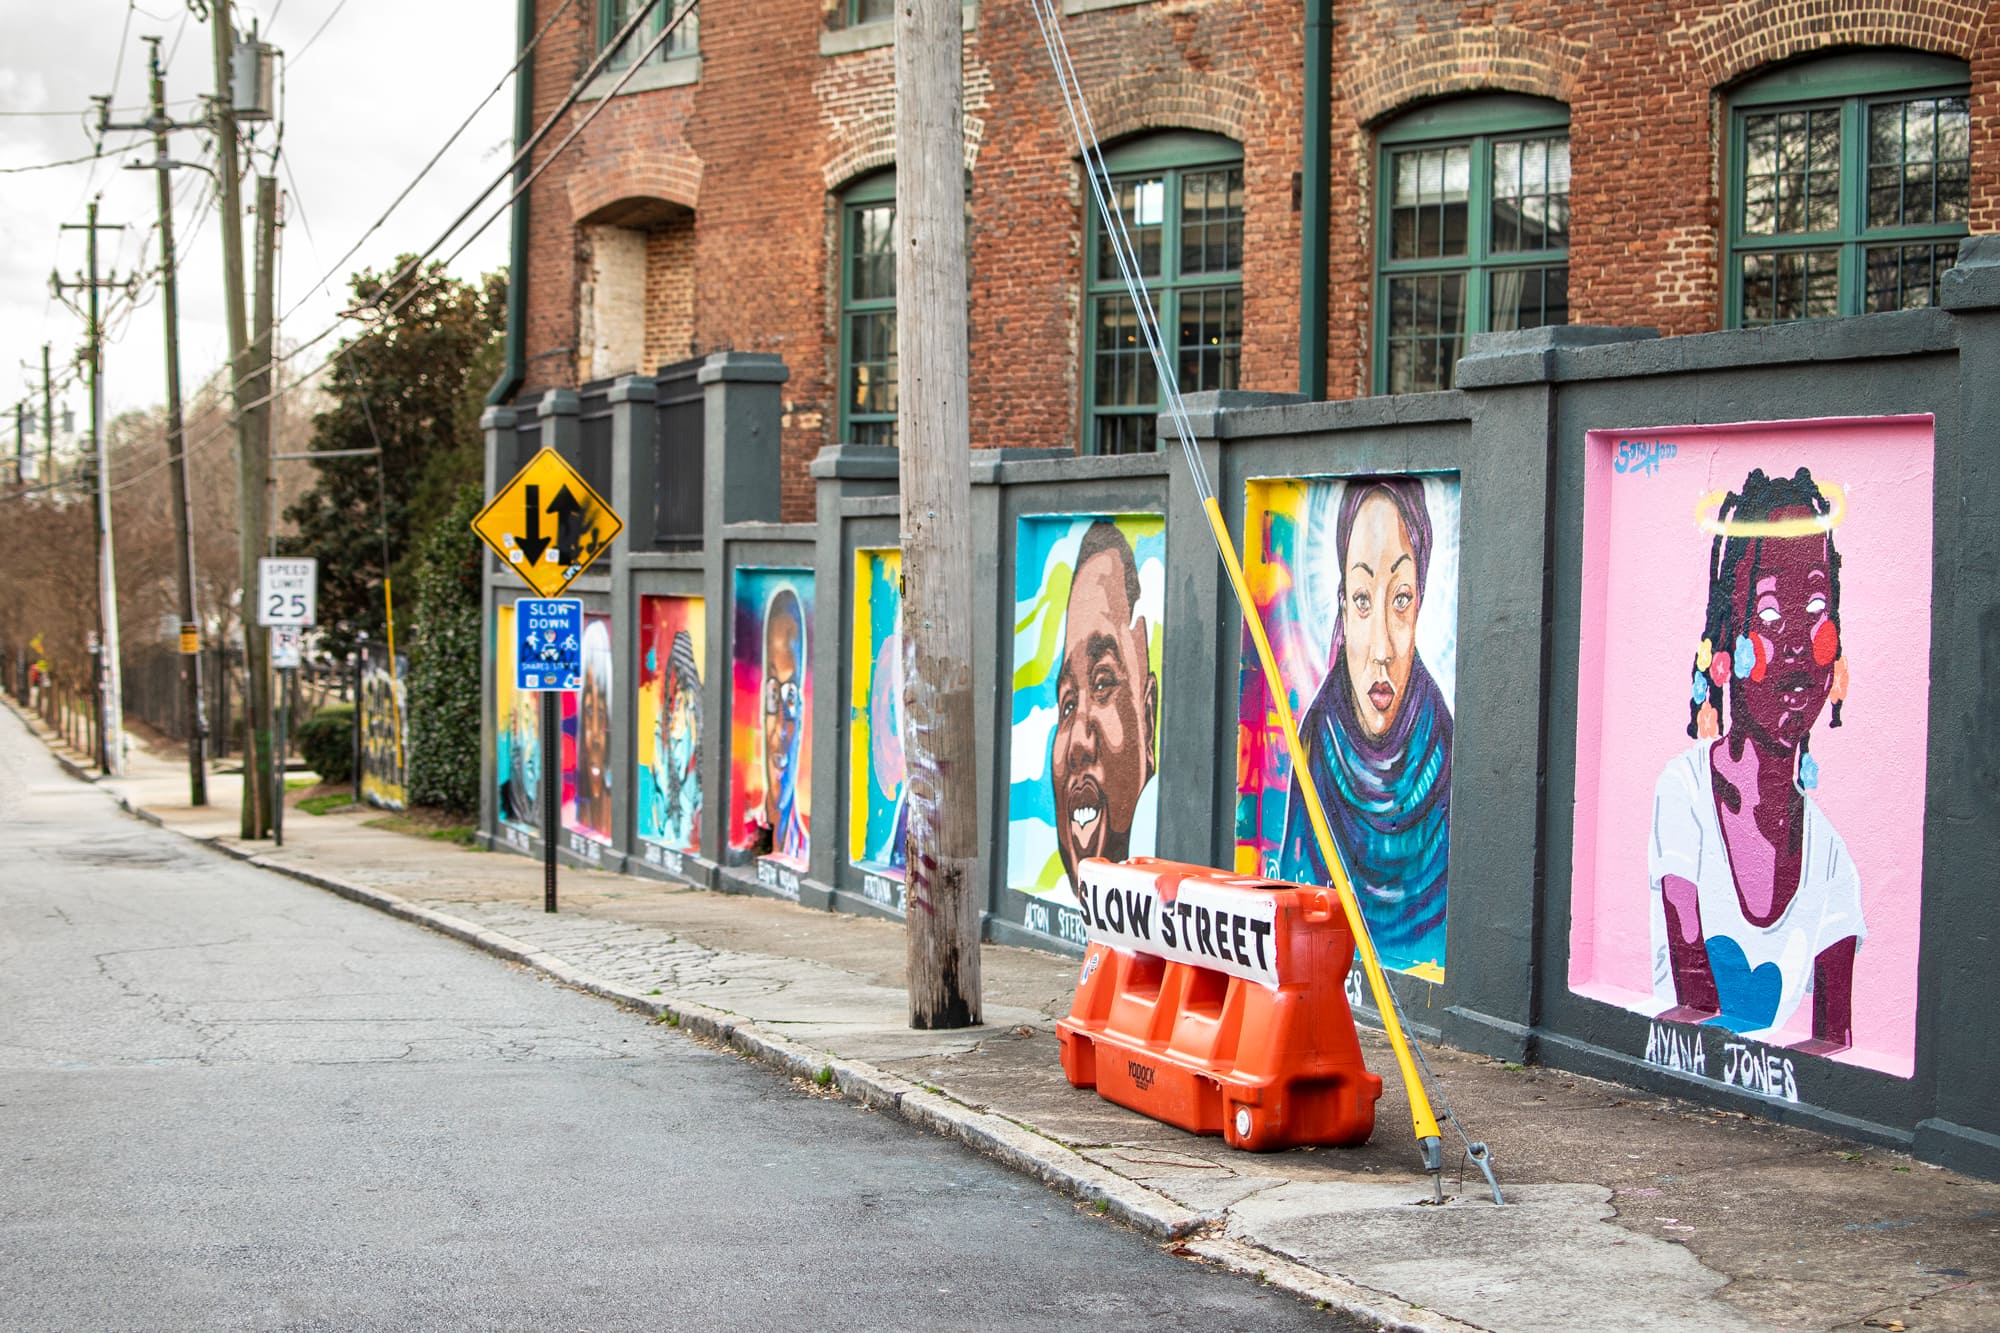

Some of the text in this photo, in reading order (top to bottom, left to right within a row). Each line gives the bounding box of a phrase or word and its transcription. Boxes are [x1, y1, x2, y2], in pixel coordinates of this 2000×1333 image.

[268, 564, 309, 576] SPEED
[270, 579, 304, 589] LIMIT
[268, 594, 306, 617] 25
[530, 603, 568, 616] SLOW
[529, 618, 569, 629] DOWN
[1079, 878, 1271, 971] SLOW STREET
[1645, 1022, 1799, 1103] AIYANA JONES
[1128, 1060, 1155, 1085] YODOCK
